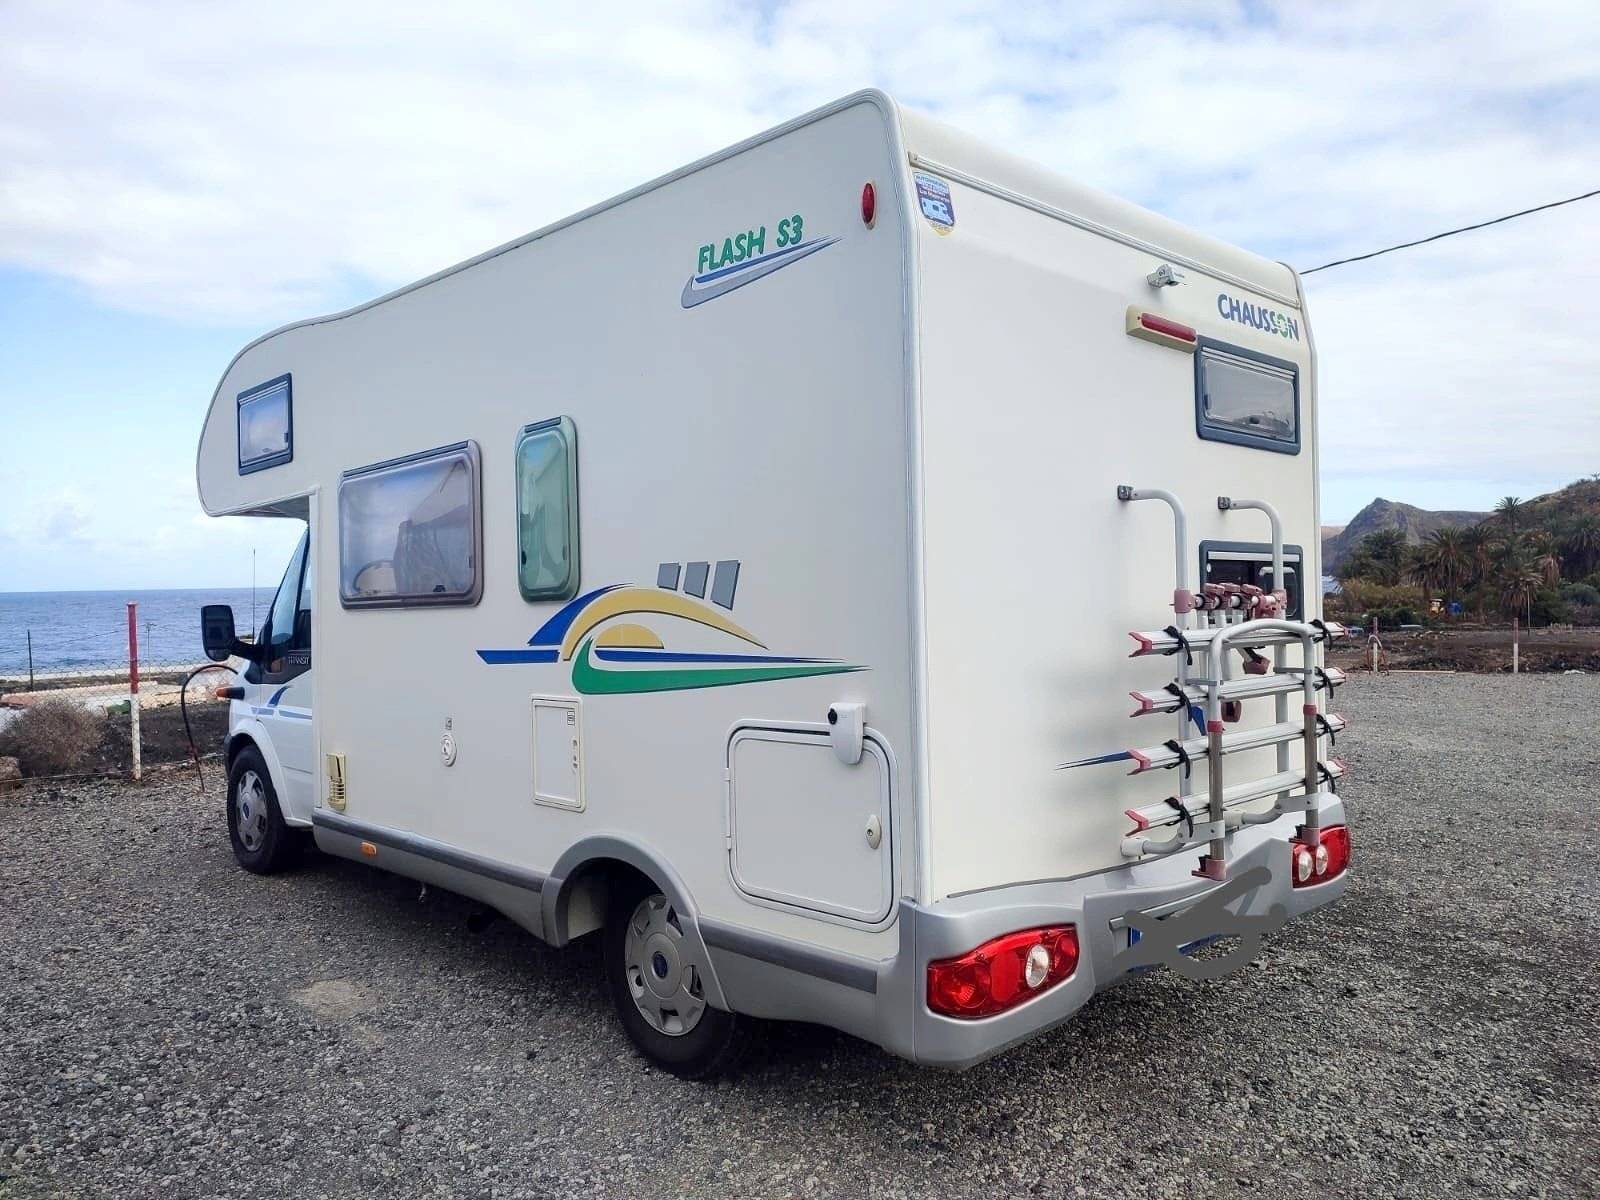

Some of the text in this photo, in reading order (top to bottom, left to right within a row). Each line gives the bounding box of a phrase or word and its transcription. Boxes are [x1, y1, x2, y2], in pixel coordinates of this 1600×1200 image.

[698, 214, 804, 274] FLASH S3
[1217, 293, 1300, 342] CHAUSSON
